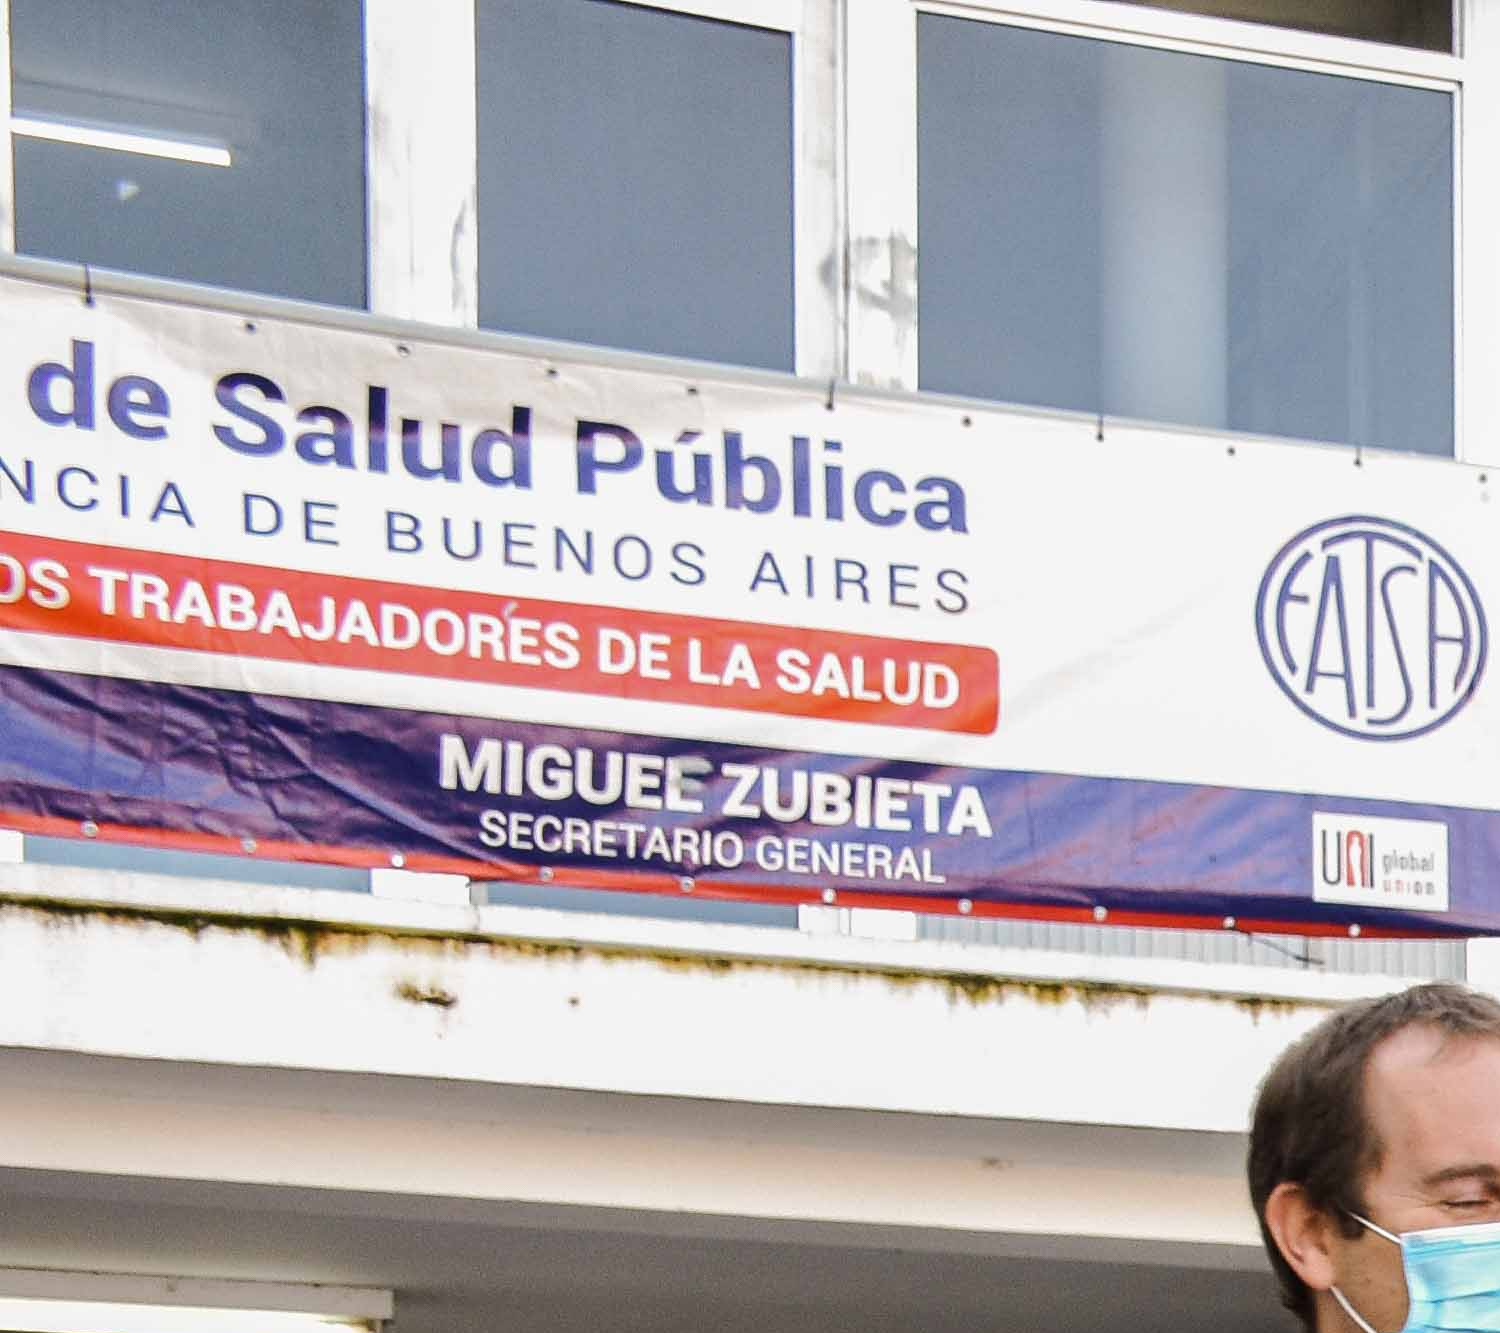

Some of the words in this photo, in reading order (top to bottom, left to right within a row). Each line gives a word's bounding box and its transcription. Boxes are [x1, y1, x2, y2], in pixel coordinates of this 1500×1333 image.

[26, 338, 172, 442] de
[211, 371, 533, 493] Salud
[576, 417, 971, 535] Pública
[0, 457, 196, 529] NCIA
[242, 493, 342, 546] DE
[387, 510, 708, 586] BUENOS
[749, 551, 971, 616] AIRES
[598, 627, 672, 681] DE
[688, 638, 761, 690] LA
[775, 648, 961, 711] SALUD
[1274, 526, 1474, 728] FATSA
[479, 810, 744, 870] SECRETARIO
[755, 837, 946, 884] GENERAL
[720, 758, 994, 838] ZUBIETA
